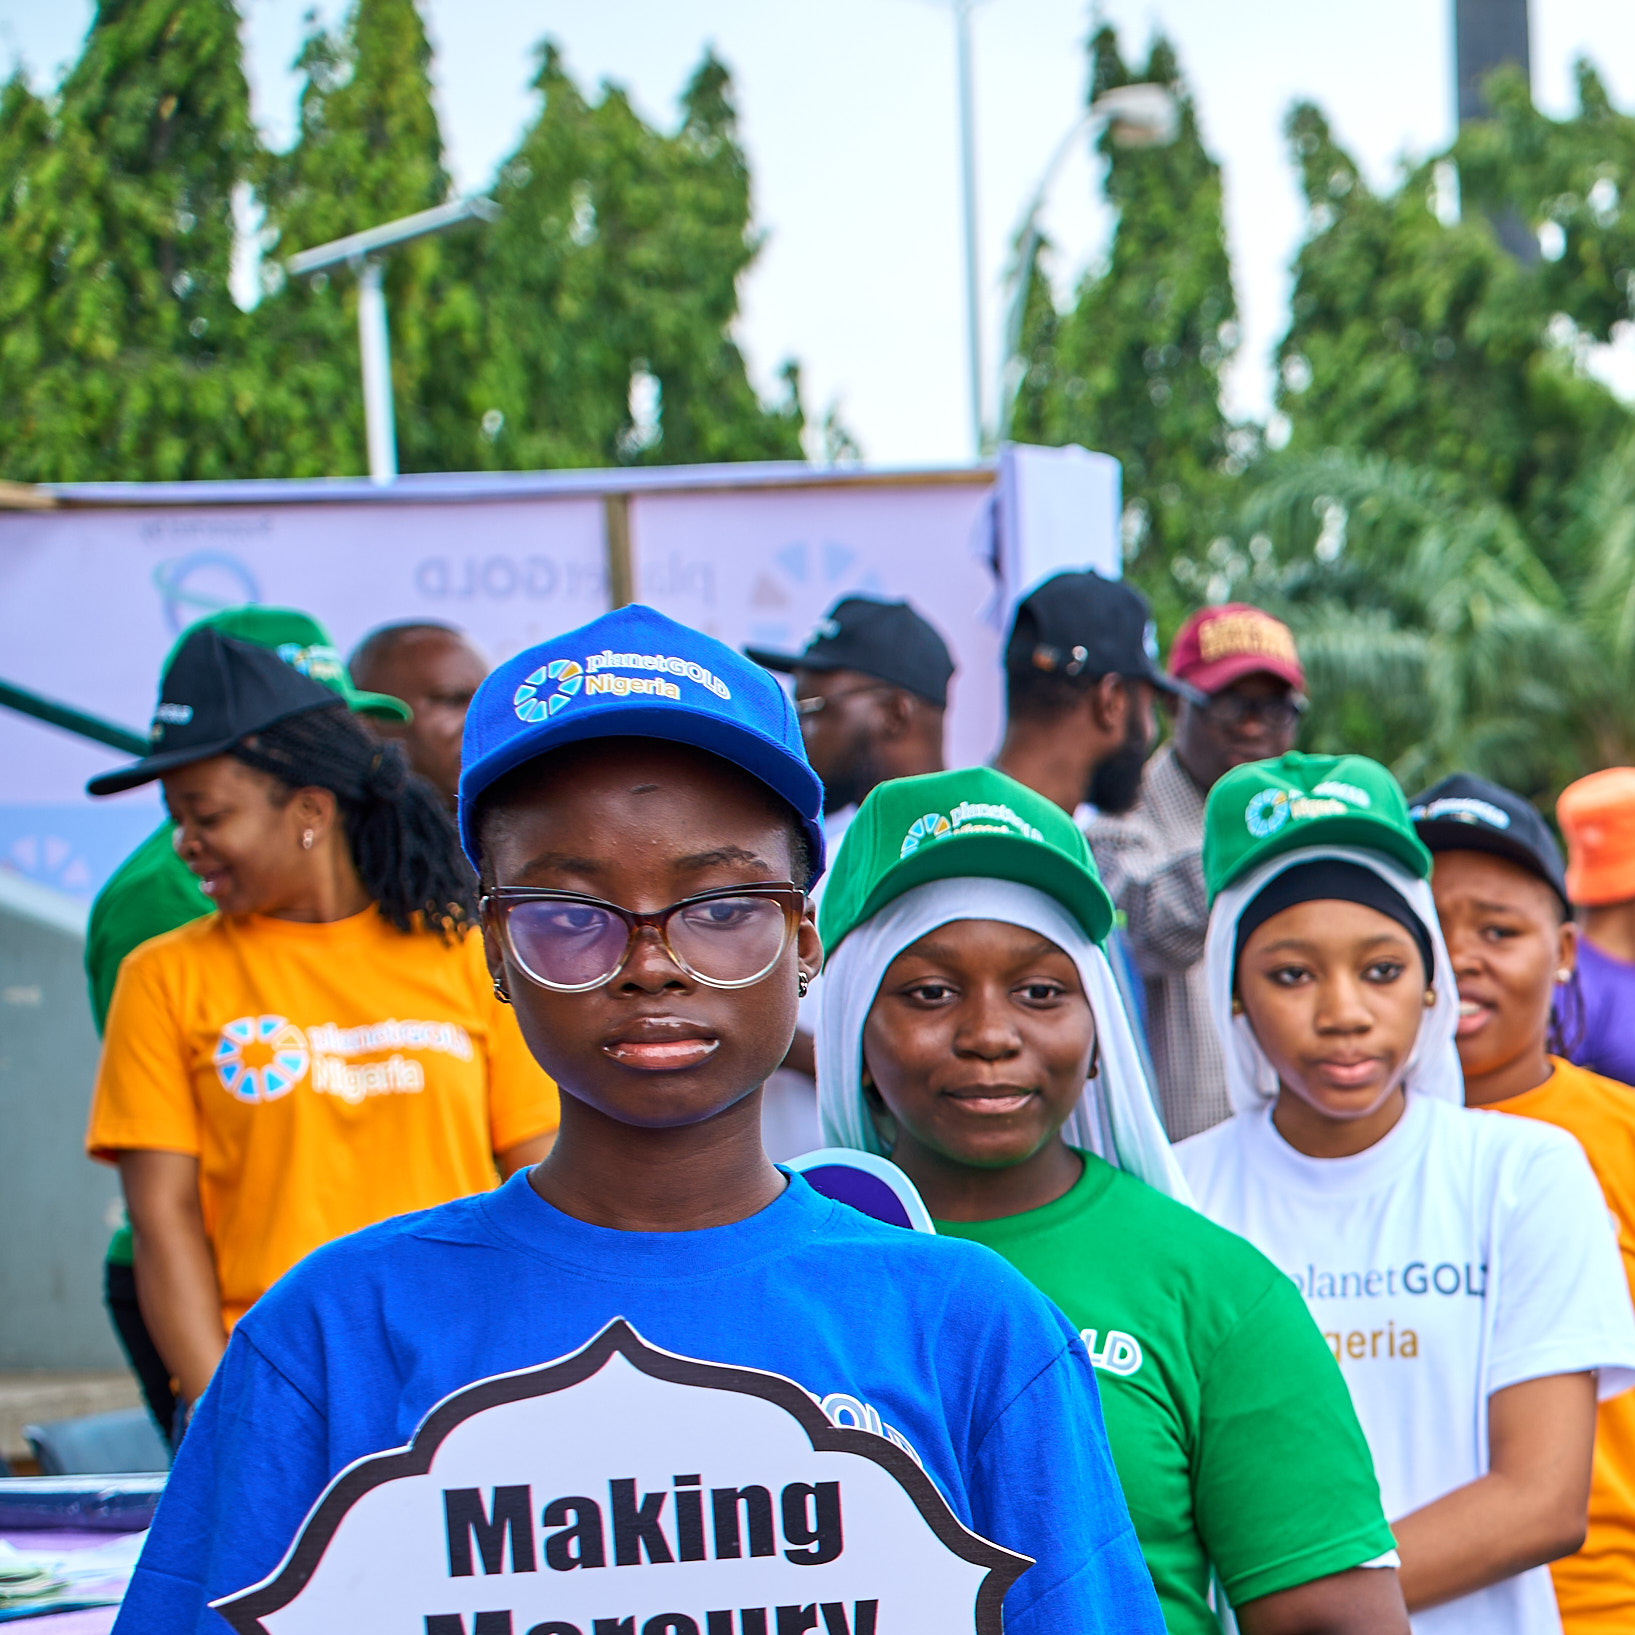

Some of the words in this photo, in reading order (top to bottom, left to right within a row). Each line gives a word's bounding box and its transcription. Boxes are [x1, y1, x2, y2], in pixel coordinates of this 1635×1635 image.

[585, 650, 732, 700] planetGOLD
[585, 674, 681, 700] Nigeria
[1290, 1262, 1489, 1298] lanetGOL
[1323, 1320, 1419, 1364] geria
[442, 1474, 845, 1578] Making
